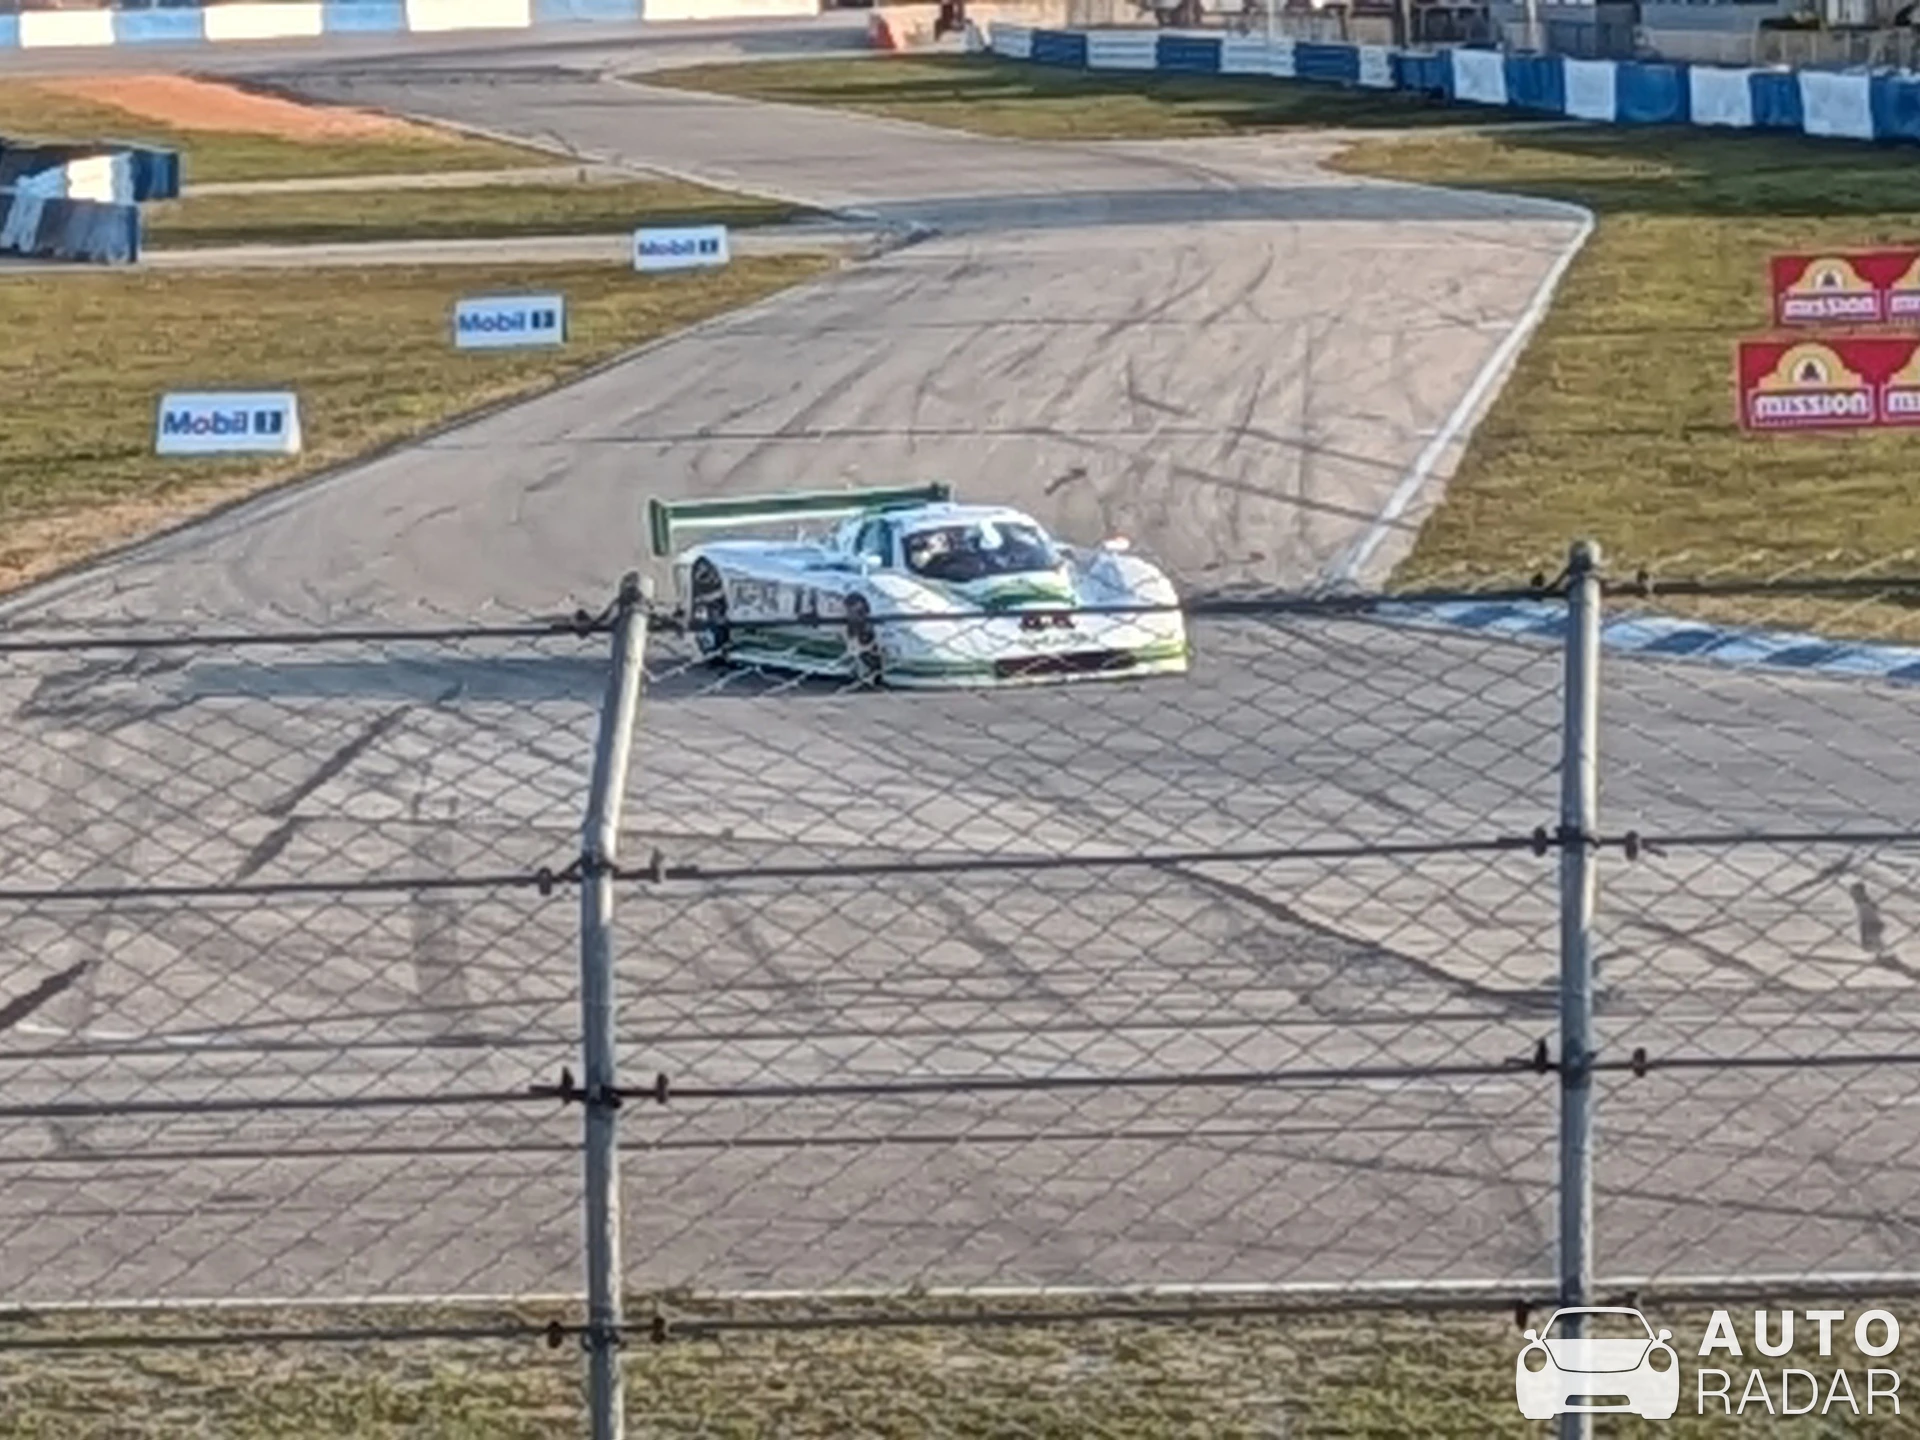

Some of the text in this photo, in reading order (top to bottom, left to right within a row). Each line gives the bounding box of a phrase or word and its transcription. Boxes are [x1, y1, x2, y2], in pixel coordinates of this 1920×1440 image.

[638, 238, 695, 256] Mobil
[459, 311, 525, 332] Mobil
[1756, 392, 1867, 418] mission
[164, 410, 248, 434] Mobil
